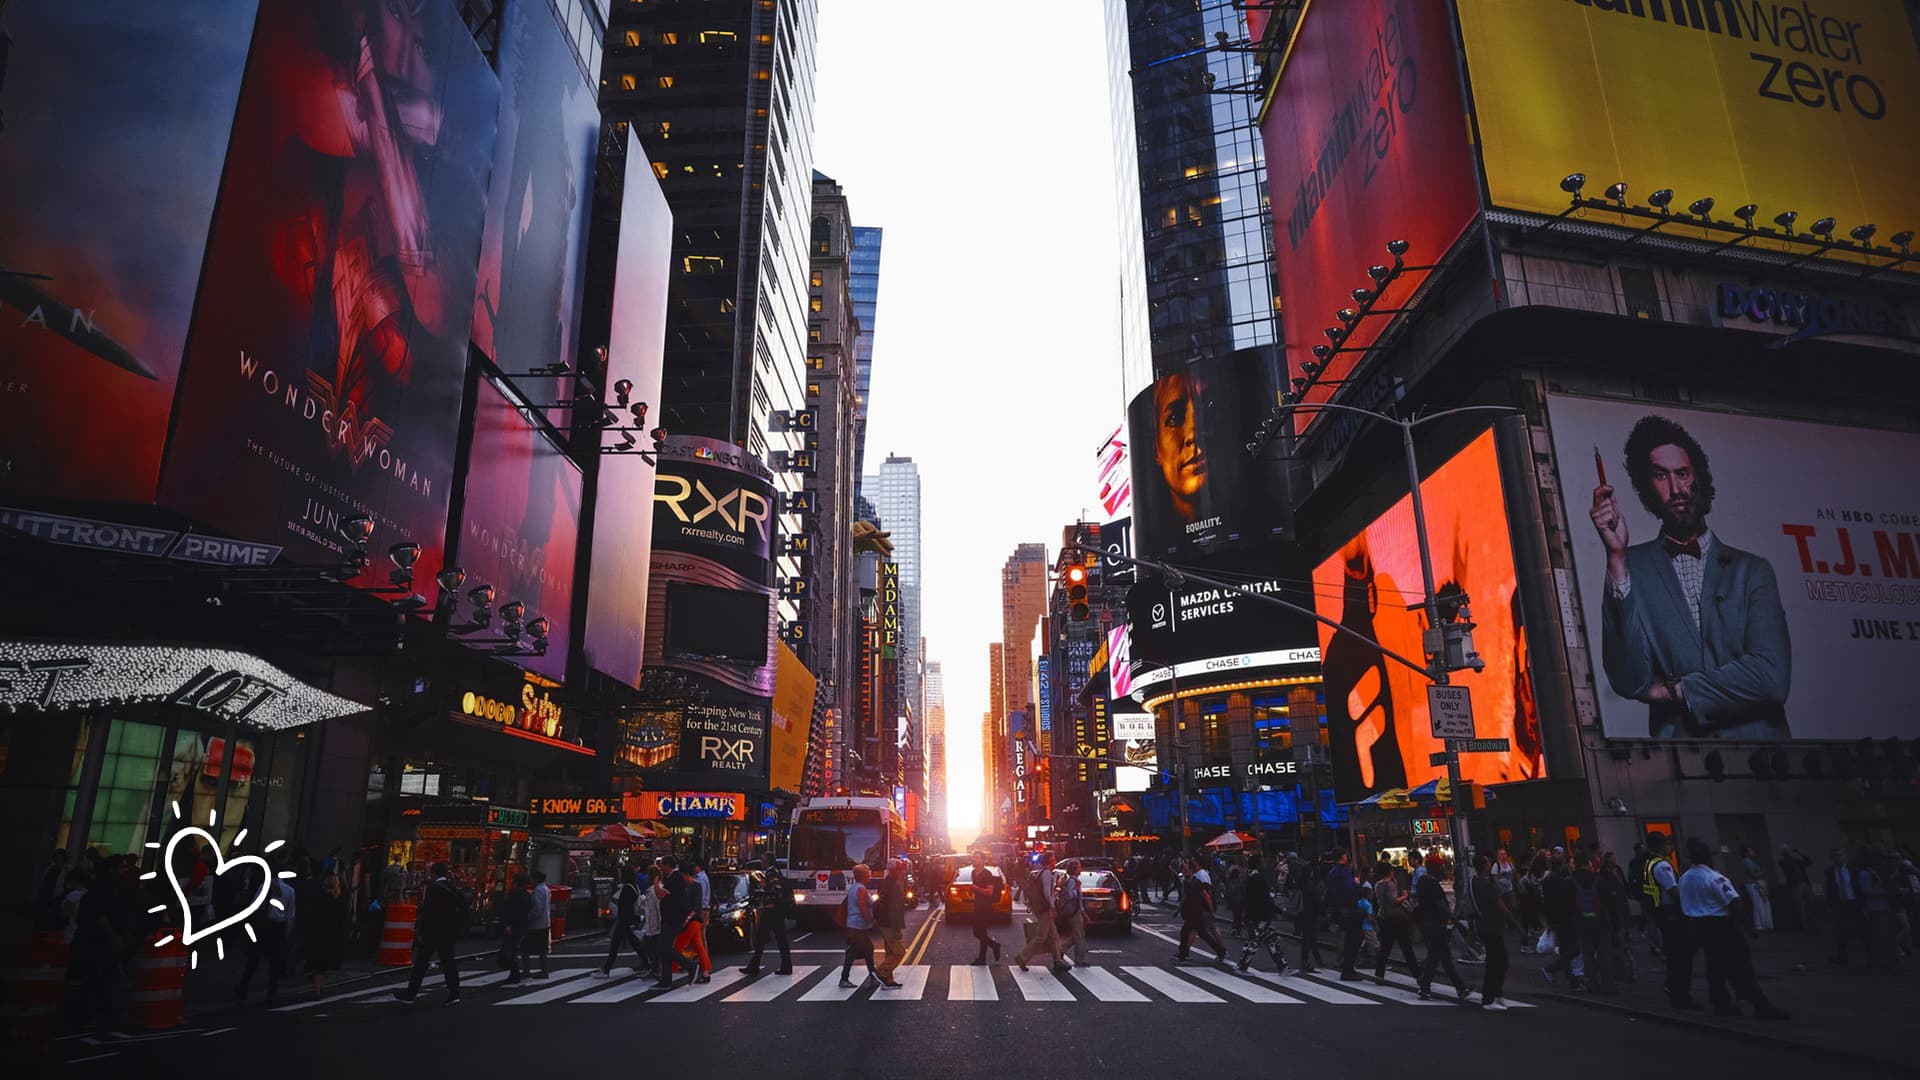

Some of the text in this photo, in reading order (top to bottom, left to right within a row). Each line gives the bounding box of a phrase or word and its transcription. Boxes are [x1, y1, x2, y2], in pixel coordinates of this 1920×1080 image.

[1750, 51, 1887, 121] zero
[1361, 56, 1416, 187] zero
[1718, 283, 1808, 326] DOW
[0, 300, 97, 335] AN
[240, 350, 432, 497] WONDER WOMAN
[247, 439, 264, 456] THE
[268, 451, 301, 476] FUTURE
[319, 481, 350, 504] JUSTICE
[352, 498, 379, 521] BEGINS
[653, 473, 769, 543] RXR
[1817, 508, 1835, 520] AN
[1841, 510, 1874, 522] HBO
[470, 520, 525, 572] WONDER
[681, 526, 746, 546] rxrrealty.com
[184, 538, 271, 565] PRIME
[1781, 524, 1920, 580] T.J. M
[650, 561, 697, 573] SHARP
[884, 562, 898, 644] MADAME
[1180, 589, 1221, 607] MAZDA
[1181, 601, 1235, 621] SERVICES
[1851, 618, 1902, 640] JUNE
[1206, 657, 1240, 670] CHASE
[1040, 672, 1049, 689] 42
[1435, 690, 1463, 700] BUSES
[687, 703, 761, 721] Shaping New York
[1040, 699, 1051, 731] STUDIOS
[1440, 701, 1460, 711] ONLY
[686, 719, 702, 730] for
[704, 720, 719, 731] the
[720, 721, 737, 733] 21st
[738, 722, 763, 739] Century
[1095, 697, 1107, 742] VICTORY
[700, 735, 754, 763] RXR
[1469, 740, 1506, 751] Broadway
[711, 761, 747, 770] REALTY
[1014, 740, 1025, 804] REGAL
[1193, 765, 1232, 779] CHASE
[1247, 761, 1297, 775] CHASE
[542, 799, 582, 814] KNOW
[658, 797, 736, 816] CHAMPS
[1415, 820, 1440, 834] SODA
